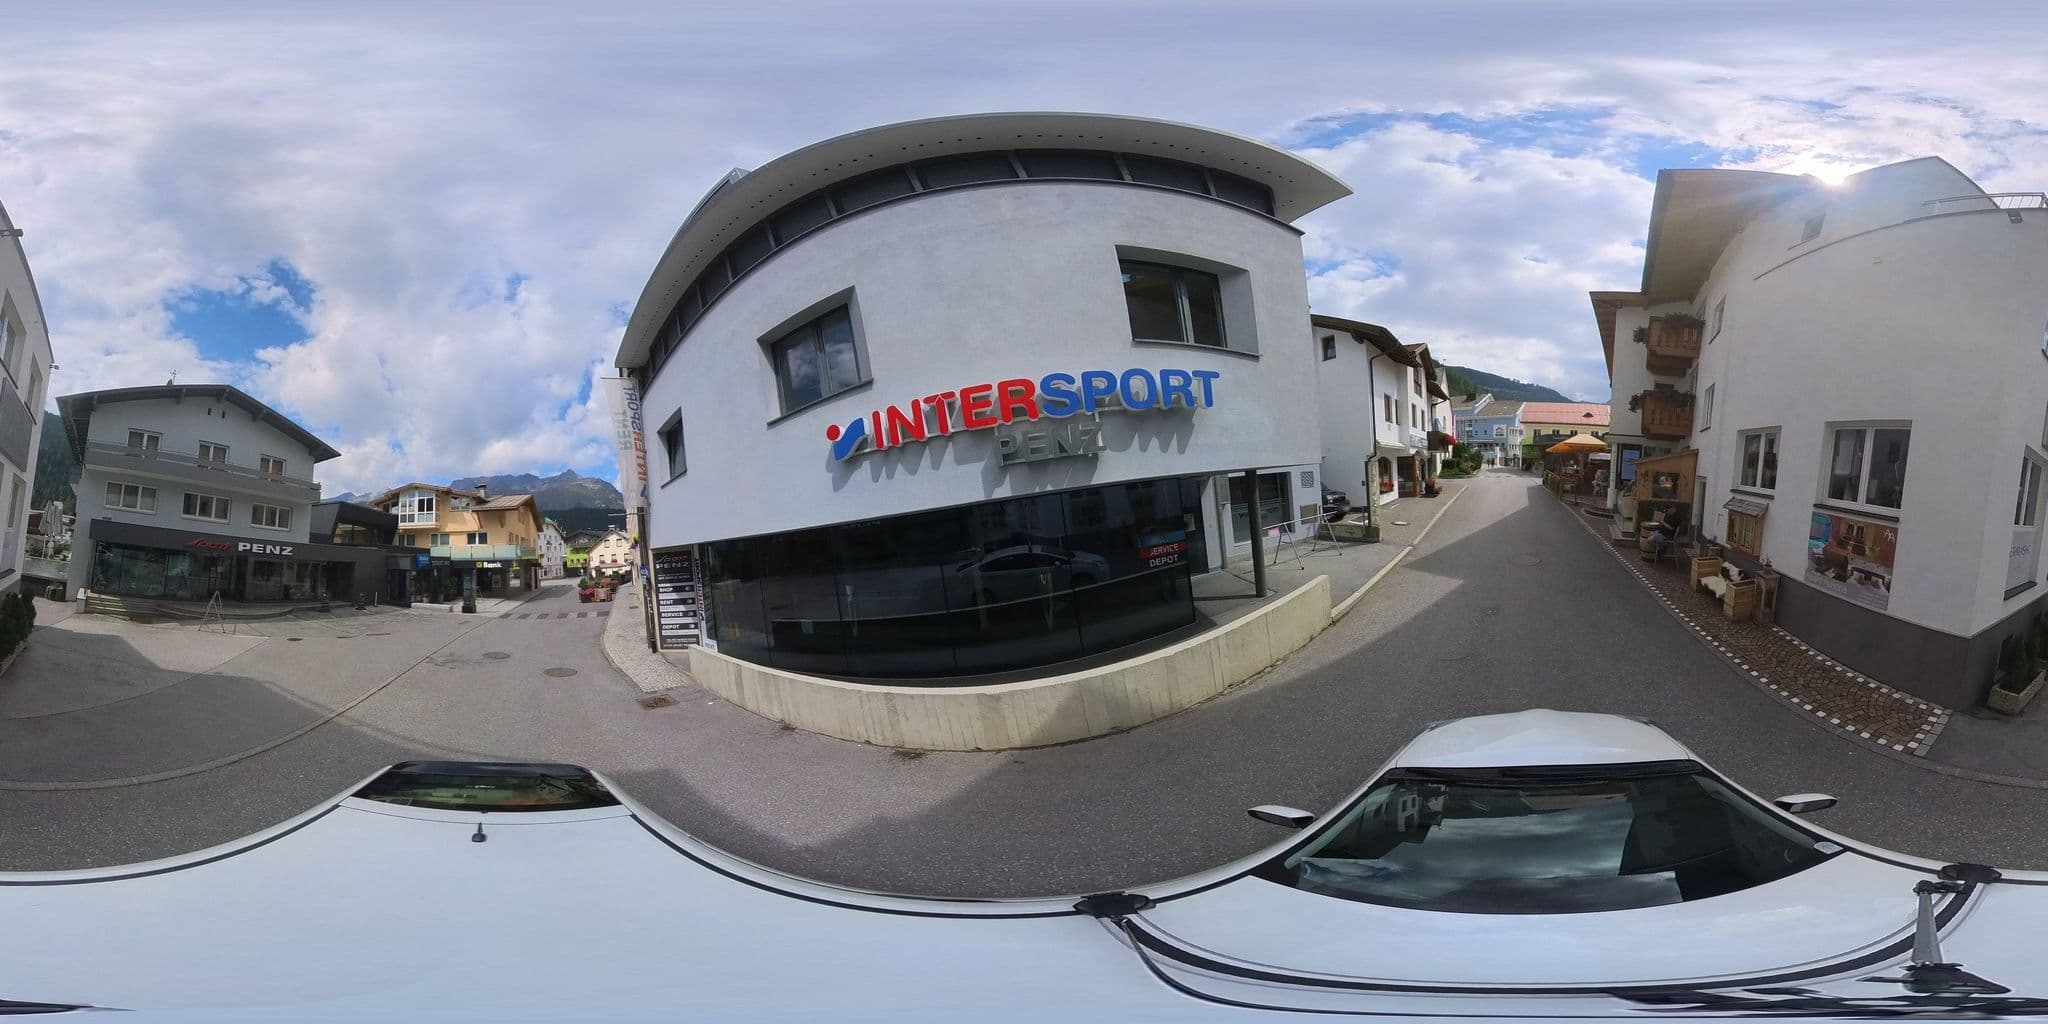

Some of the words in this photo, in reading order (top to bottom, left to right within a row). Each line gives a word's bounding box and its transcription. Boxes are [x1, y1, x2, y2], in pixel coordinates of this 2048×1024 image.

[871, 368, 1220, 450] INTERSPORT
[999, 422, 1107, 467] PENZ
[238, 542, 293, 555] PENZ
[656, 561, 690, 569] PENZ
[1150, 554, 1179, 567] DEPOT
